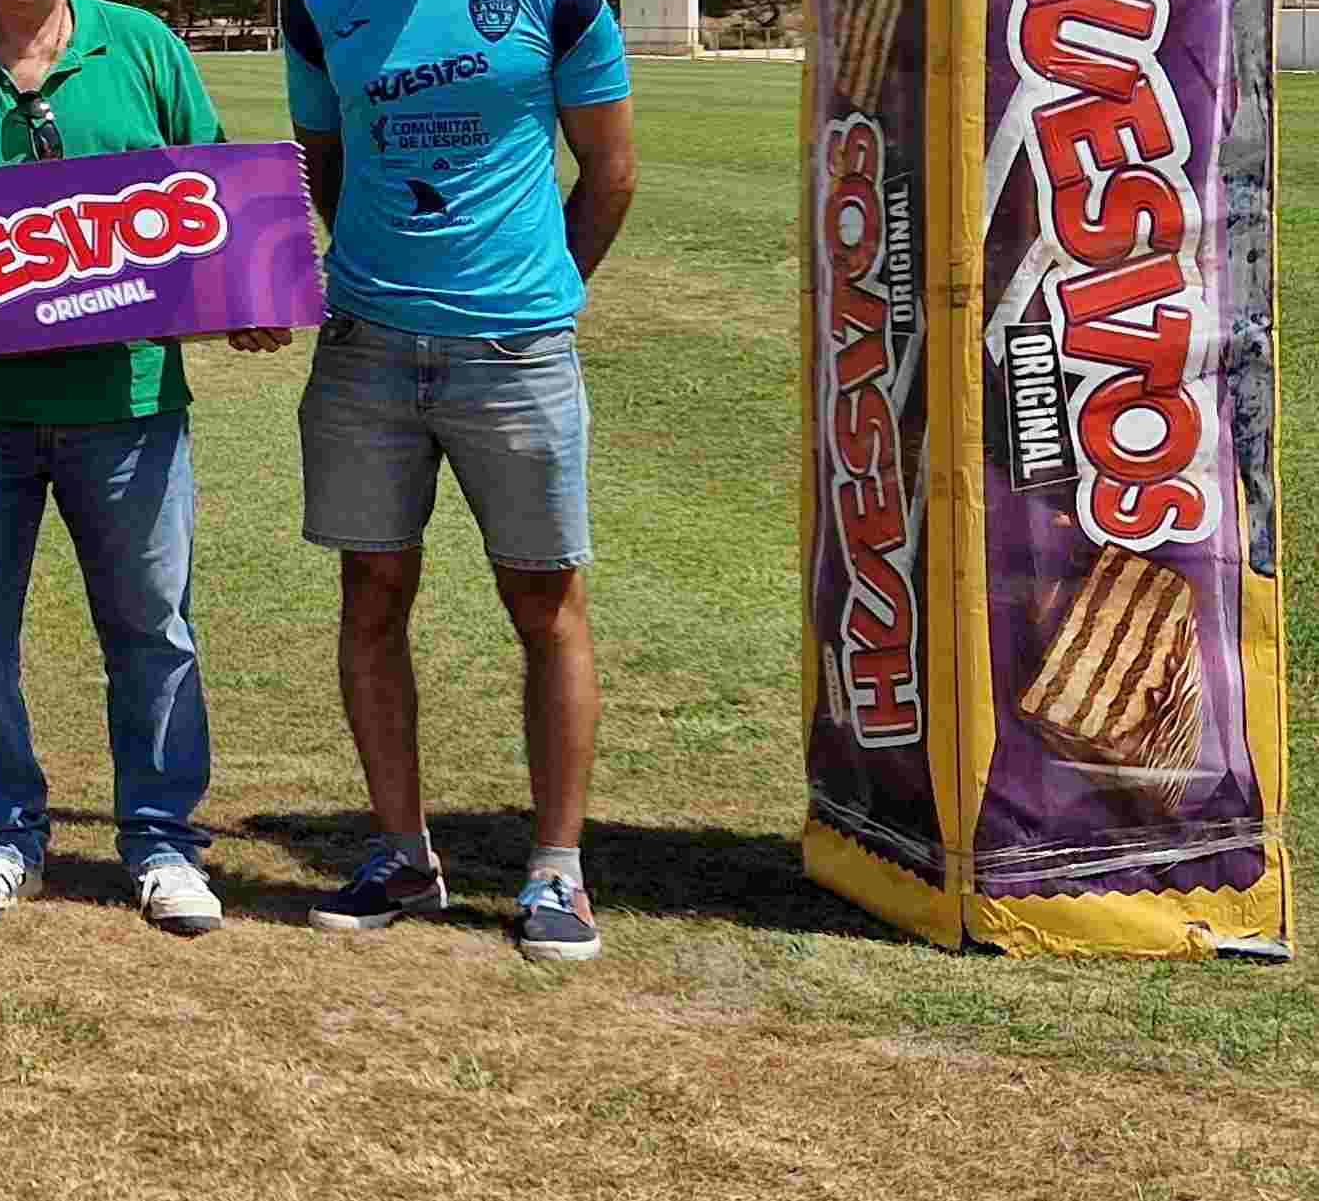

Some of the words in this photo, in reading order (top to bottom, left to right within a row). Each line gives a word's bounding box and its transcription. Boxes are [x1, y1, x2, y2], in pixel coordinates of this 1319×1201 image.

[365, 52, 489, 106] HUESITOS
[35, 277, 156, 326] ORIGINAL
[892, 184, 913, 322] ORIGINAL
[827, 124, 916, 732] HUESITOS
[1010, 332, 1066, 481] ORIGINAL
